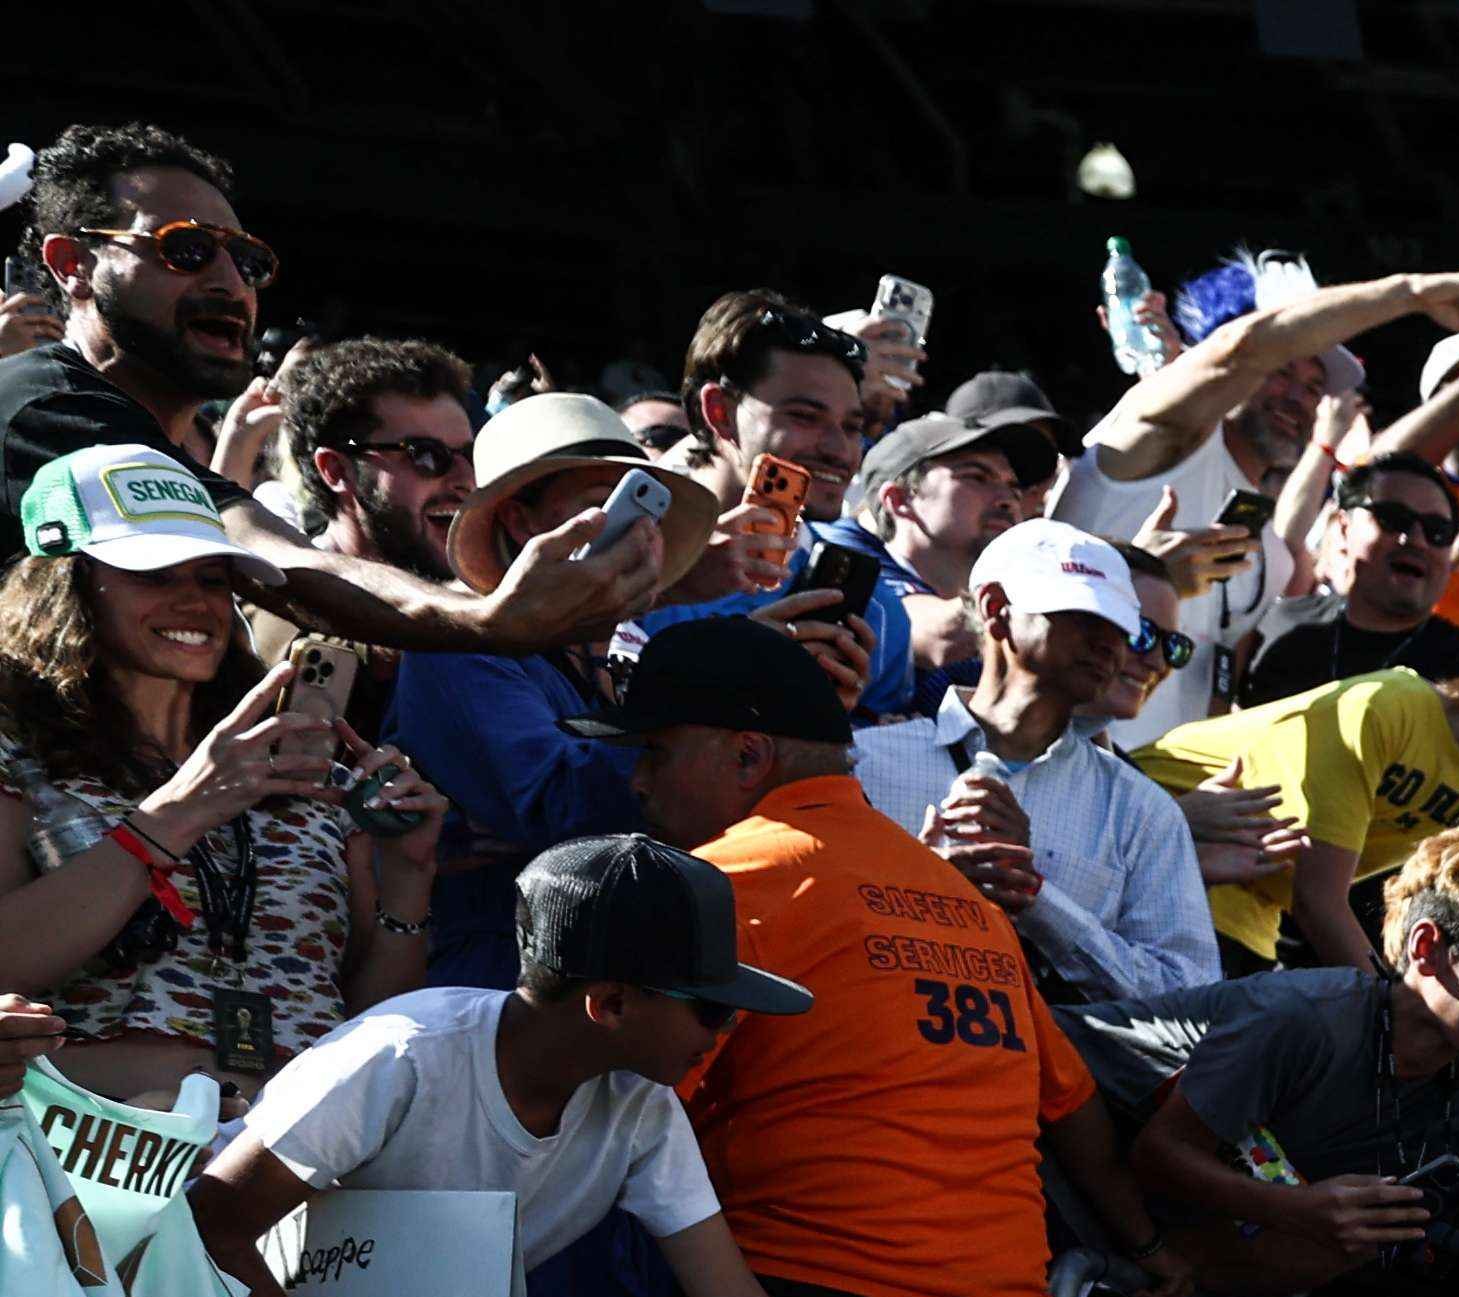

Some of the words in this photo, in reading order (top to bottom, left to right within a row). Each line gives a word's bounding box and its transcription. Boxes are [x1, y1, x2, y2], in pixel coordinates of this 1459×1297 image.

[127, 479, 217, 513] SENEGAL
[857, 884, 989, 932] SAFETY
[864, 934, 1021, 988] SERVICES
[914, 978, 1027, 1052] 381
[40, 1103, 199, 1199] CHERKI
